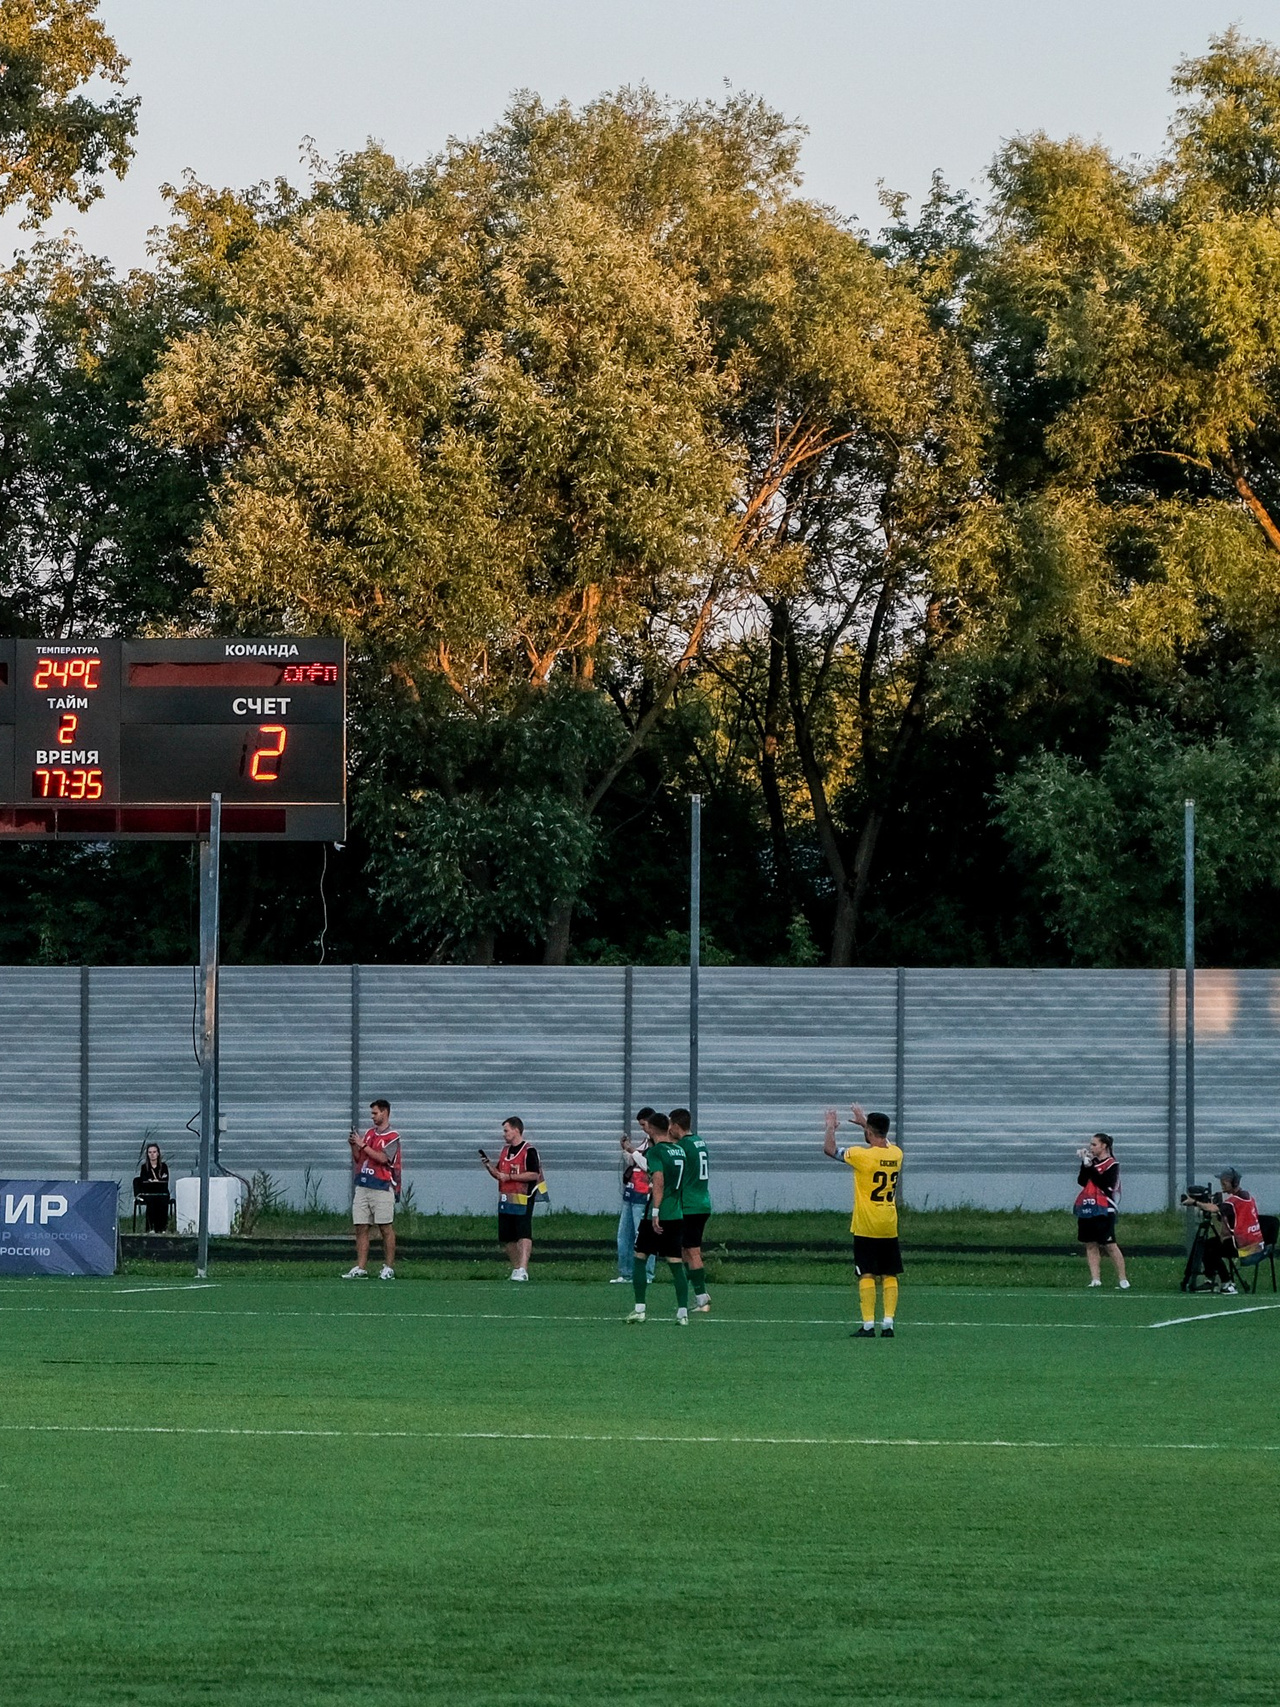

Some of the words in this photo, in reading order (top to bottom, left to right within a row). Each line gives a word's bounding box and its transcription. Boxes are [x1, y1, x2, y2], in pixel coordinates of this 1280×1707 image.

[35, 646, 100, 655] ТЕМПЕРАТУРА
[224, 644, 300, 658] КОМАНДА
[46, 694, 89, 709] ТАЙМ
[232, 697, 292, 715] СЧЕТ
[59, 714, 78, 744] 2
[36, 750, 99, 765] ВРЕМЯ
[250, 724, 287, 781] 2
[34, 769, 103, 799] 77:35
[673, 1159, 685, 1190] 7
[698, 1151, 709, 1181] 6
[870, 1170, 899, 1203] 23
